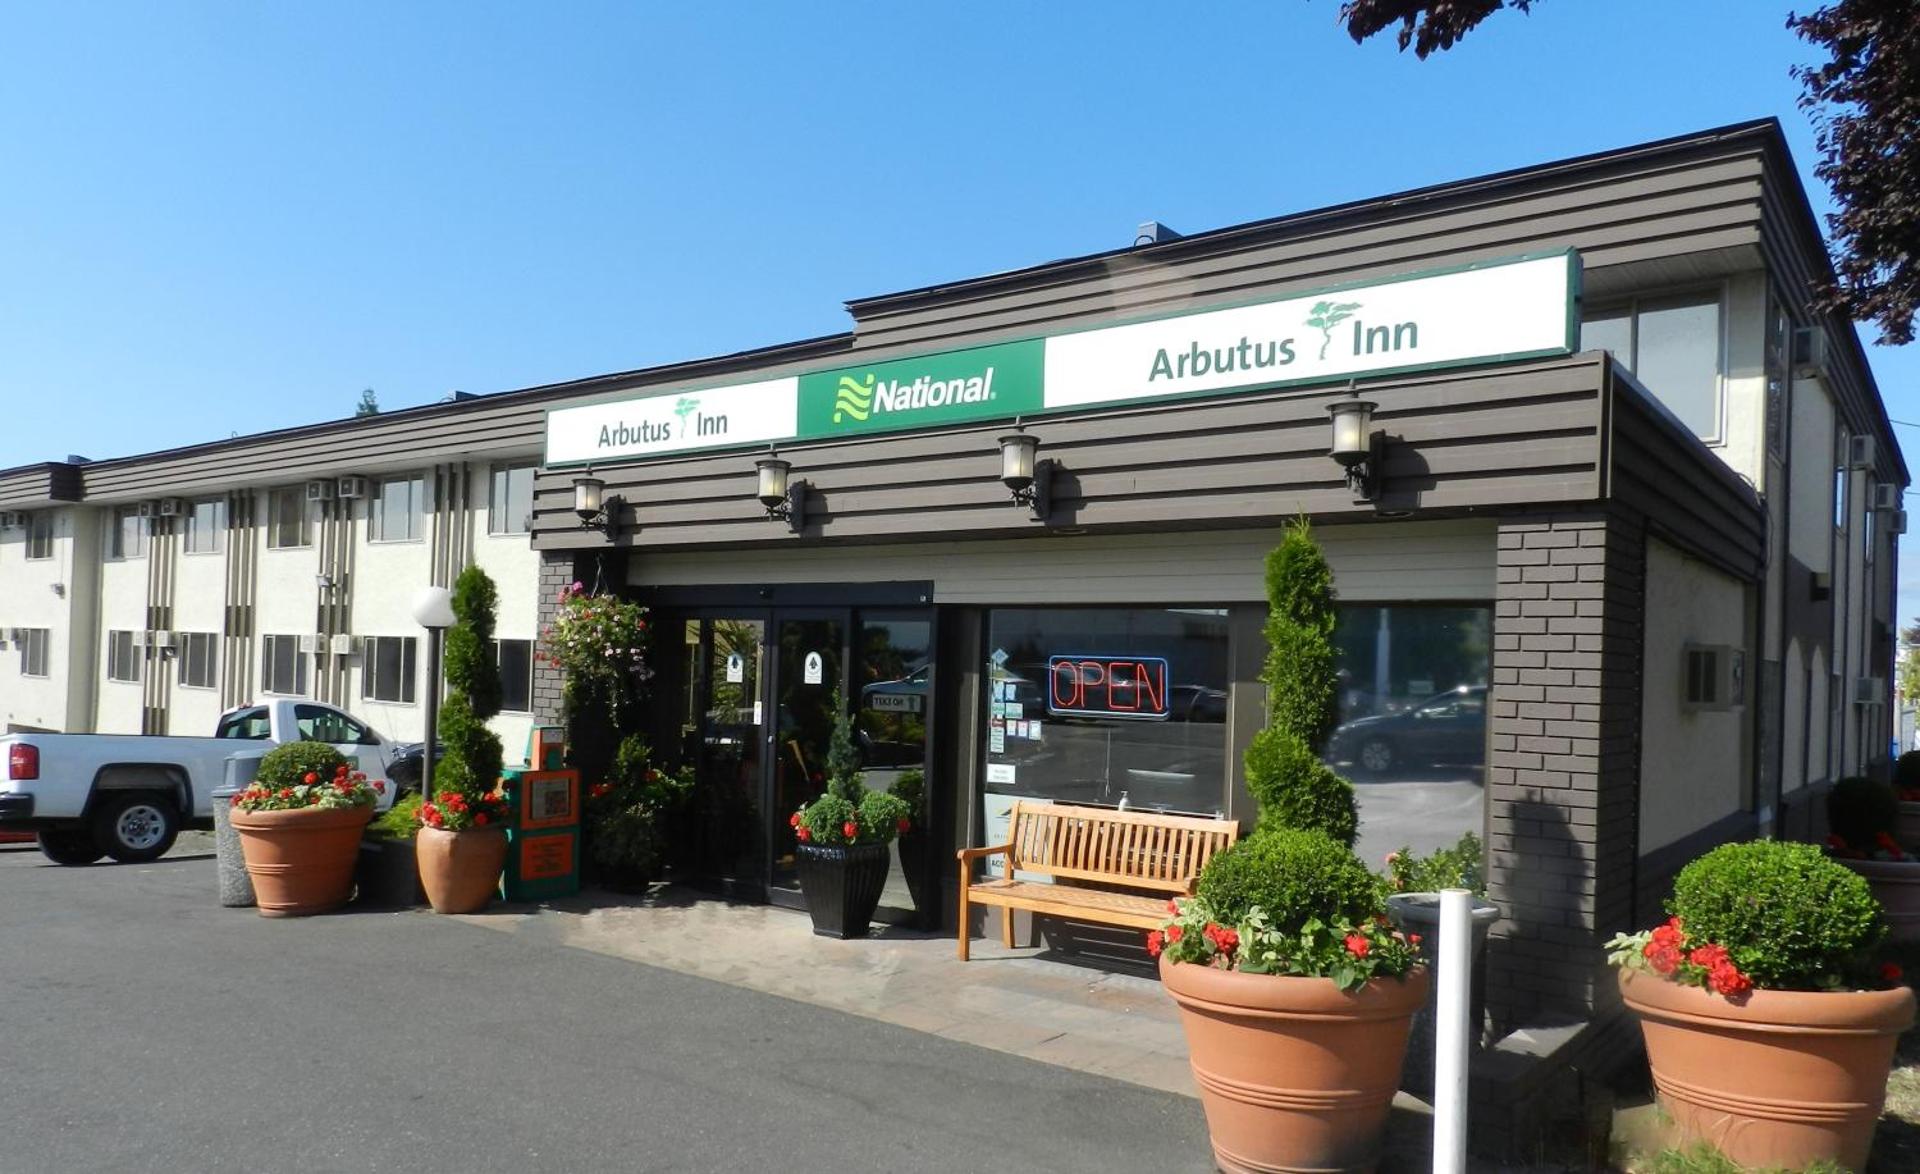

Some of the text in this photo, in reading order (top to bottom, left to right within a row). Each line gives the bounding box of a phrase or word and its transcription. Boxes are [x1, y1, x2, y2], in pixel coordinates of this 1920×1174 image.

[1148, 320, 1418, 382] Arbutus Inn
[598, 411, 728, 448] Arbutus Inn
[1054, 661, 1164, 711] OPEN
